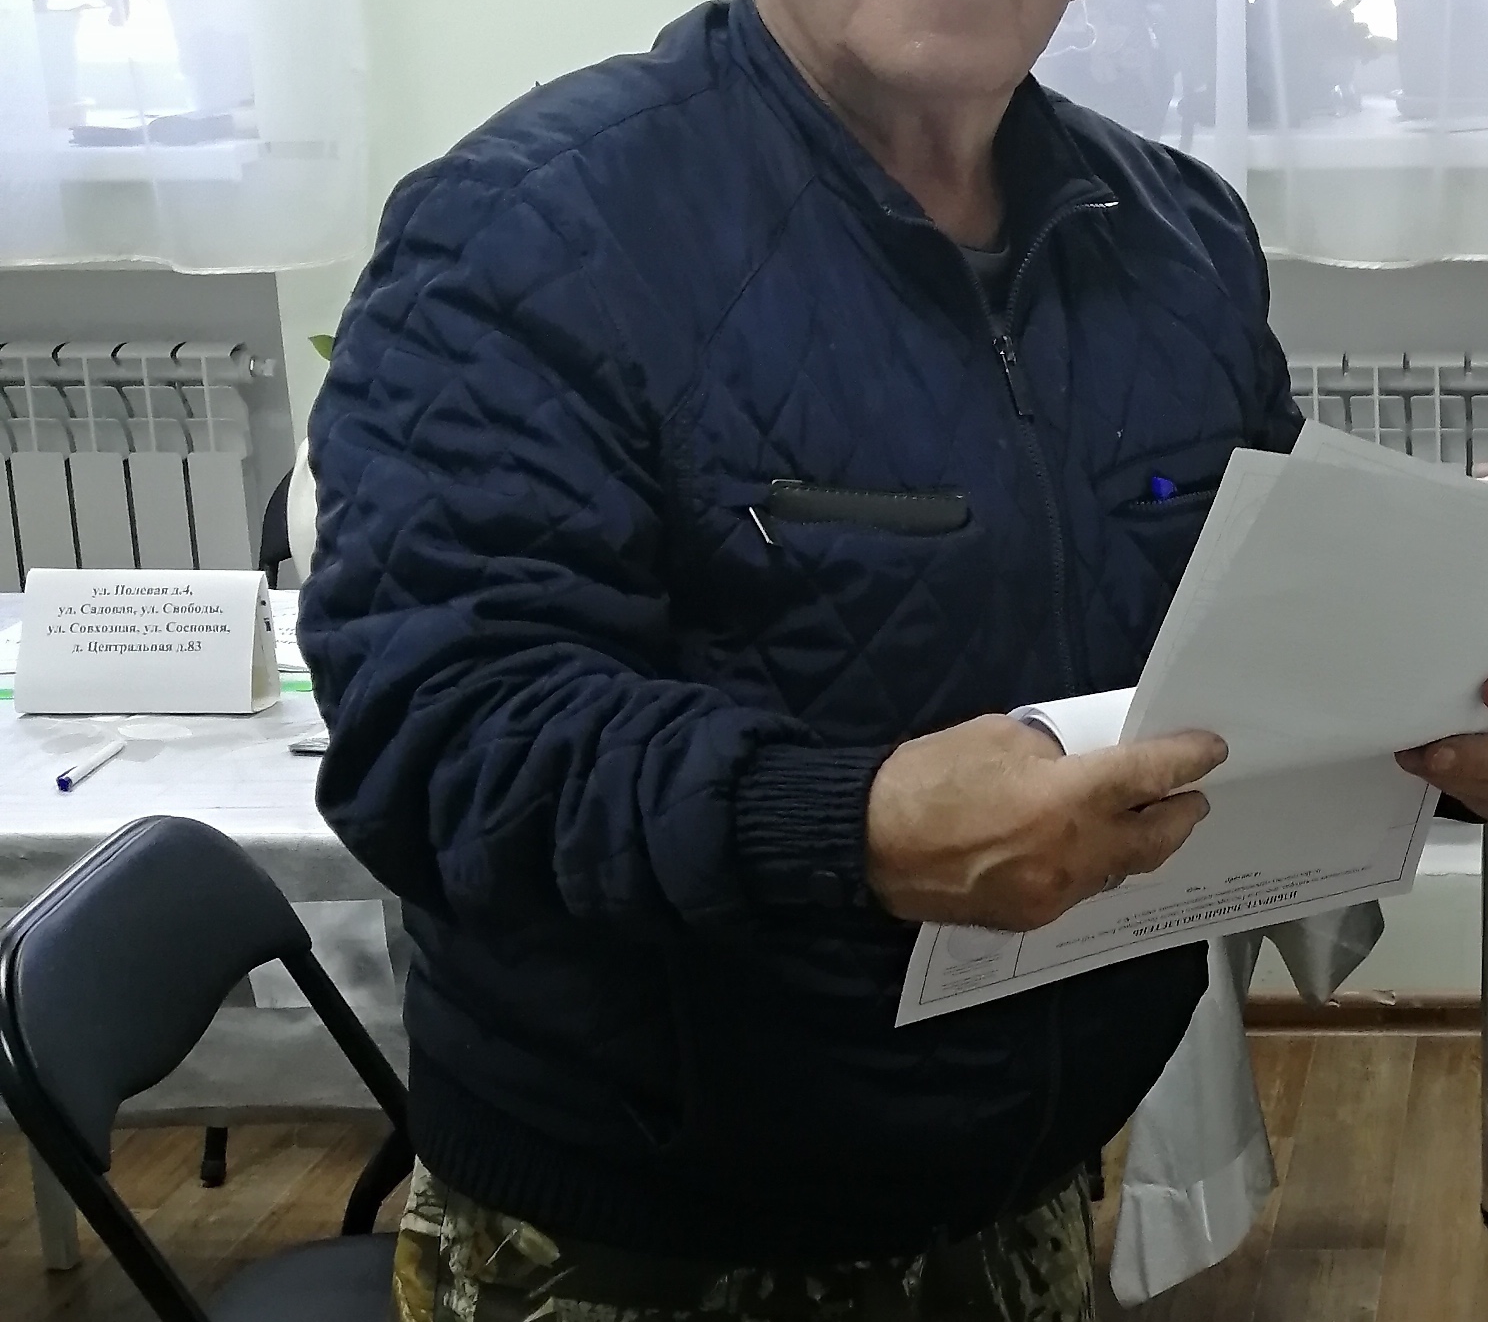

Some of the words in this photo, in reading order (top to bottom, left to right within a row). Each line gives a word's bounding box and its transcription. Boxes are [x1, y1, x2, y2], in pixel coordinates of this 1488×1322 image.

[91, 587, 111, 598] ул.
[114, 584, 169, 596] Полевая
[57, 606, 77, 618] ул.
[80, 603, 138, 615] Садовая,
[140, 605, 159, 617] ул.
[46, 625, 66, 636] ул.
[142, 625, 162, 636] ул.
[88, 641, 173, 655] Центральная
